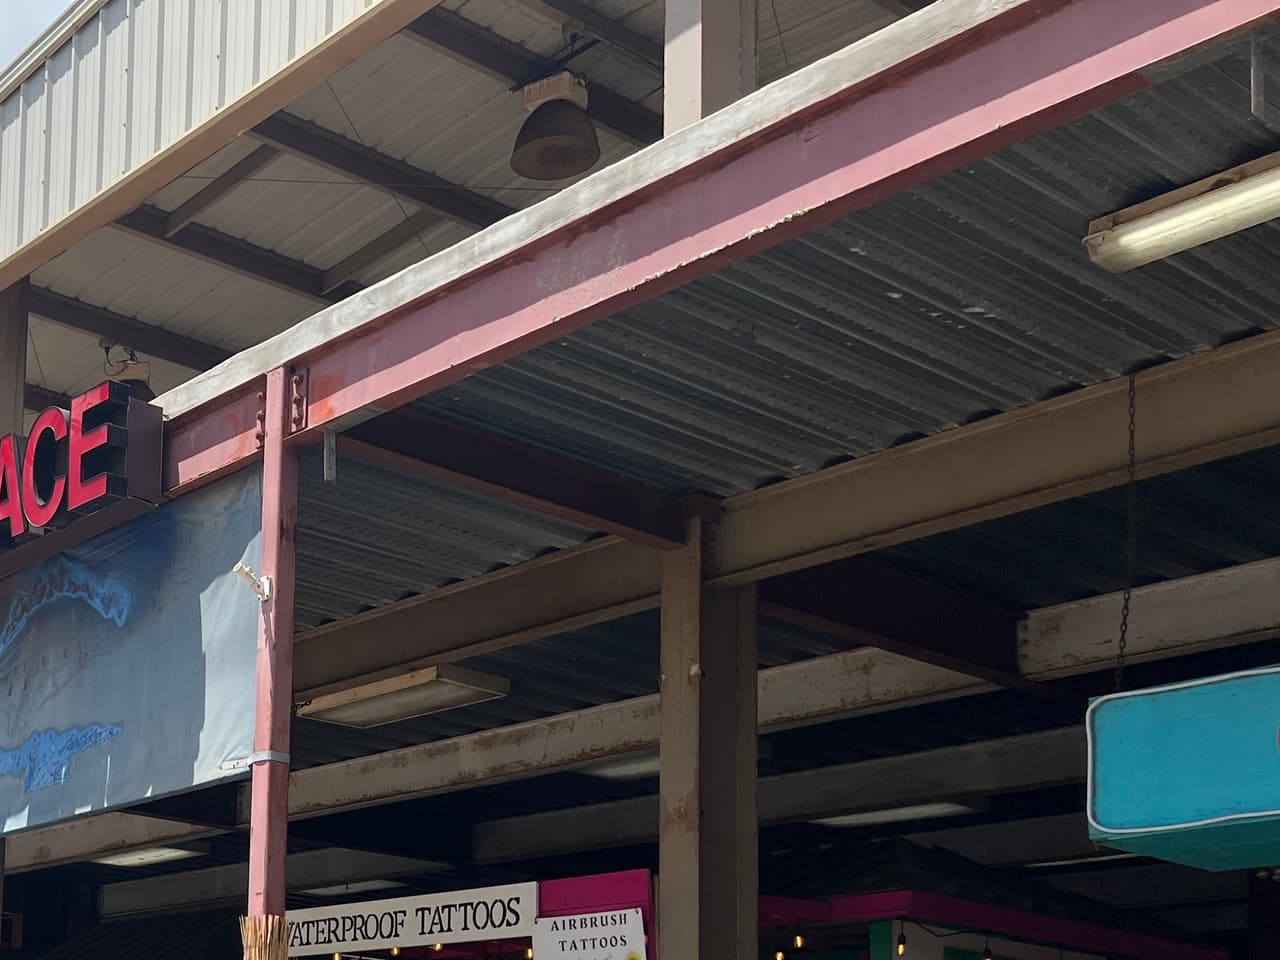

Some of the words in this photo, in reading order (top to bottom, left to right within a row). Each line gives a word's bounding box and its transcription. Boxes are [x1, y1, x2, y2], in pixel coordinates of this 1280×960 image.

[287, 910, 407, 948] ATERPROOF
[415, 897, 521, 936] TATTOOS
[550, 912, 628, 932] AIRBRUSH
[558, 934, 628, 952] TATTOOS
